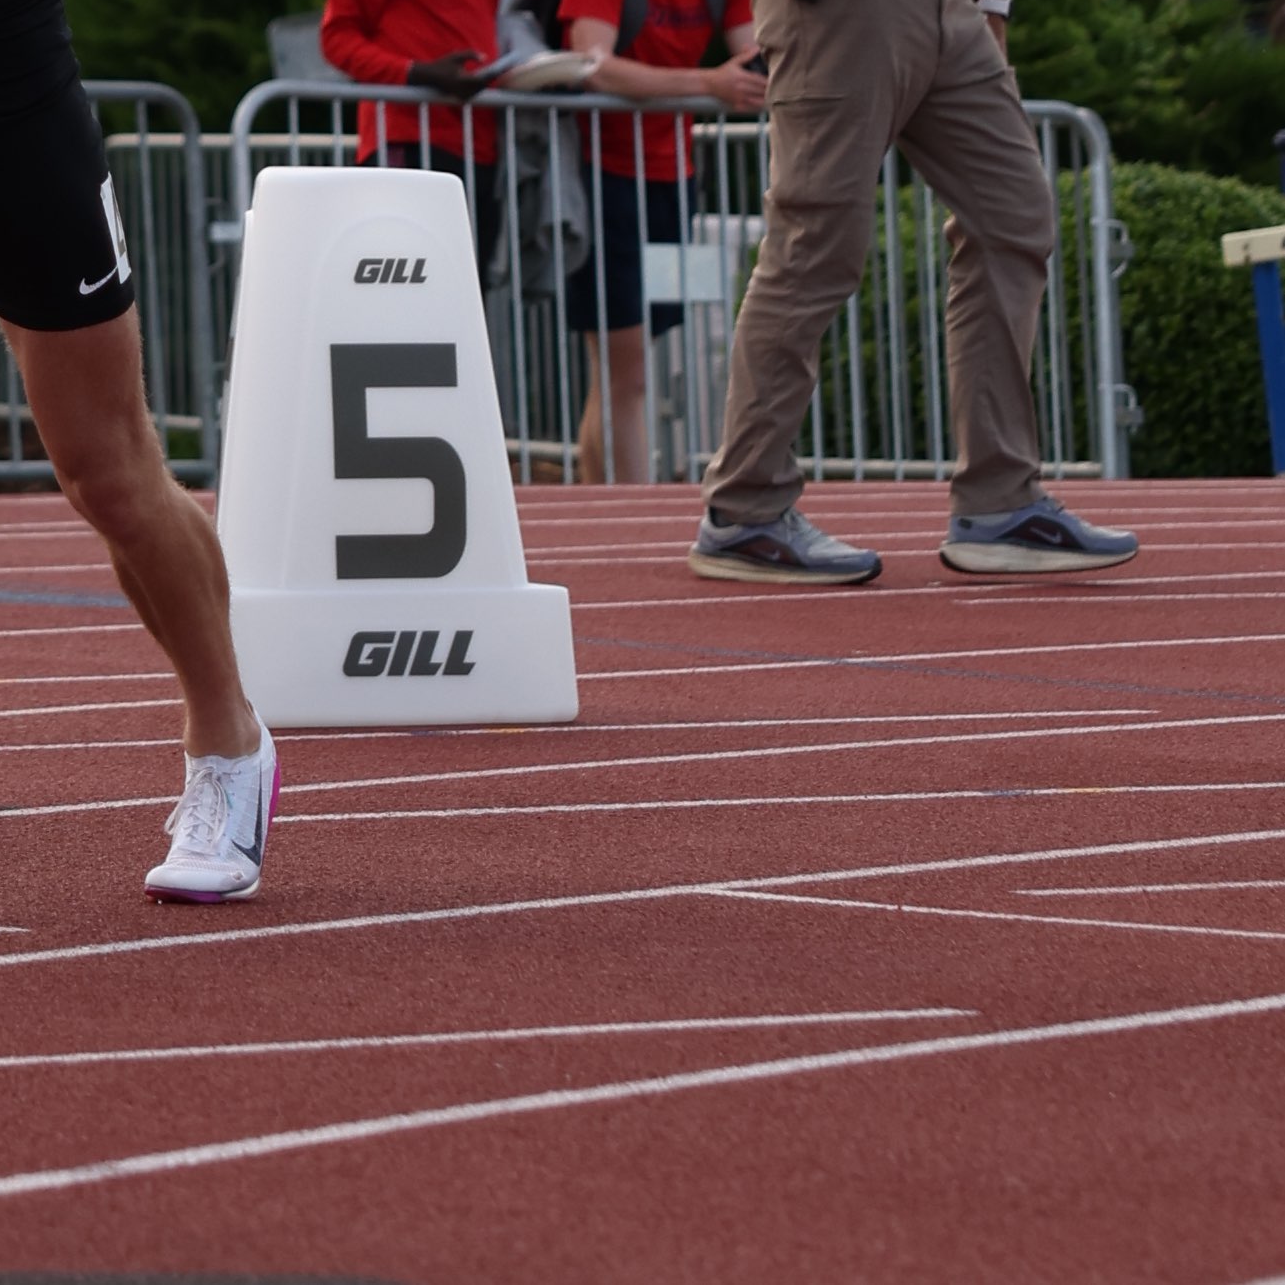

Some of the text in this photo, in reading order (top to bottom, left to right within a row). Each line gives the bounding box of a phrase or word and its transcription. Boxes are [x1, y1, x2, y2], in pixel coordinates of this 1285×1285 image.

[353, 257, 428, 284] GILL
[330, 343, 467, 580] 5
[342, 630, 476, 678] GILL
